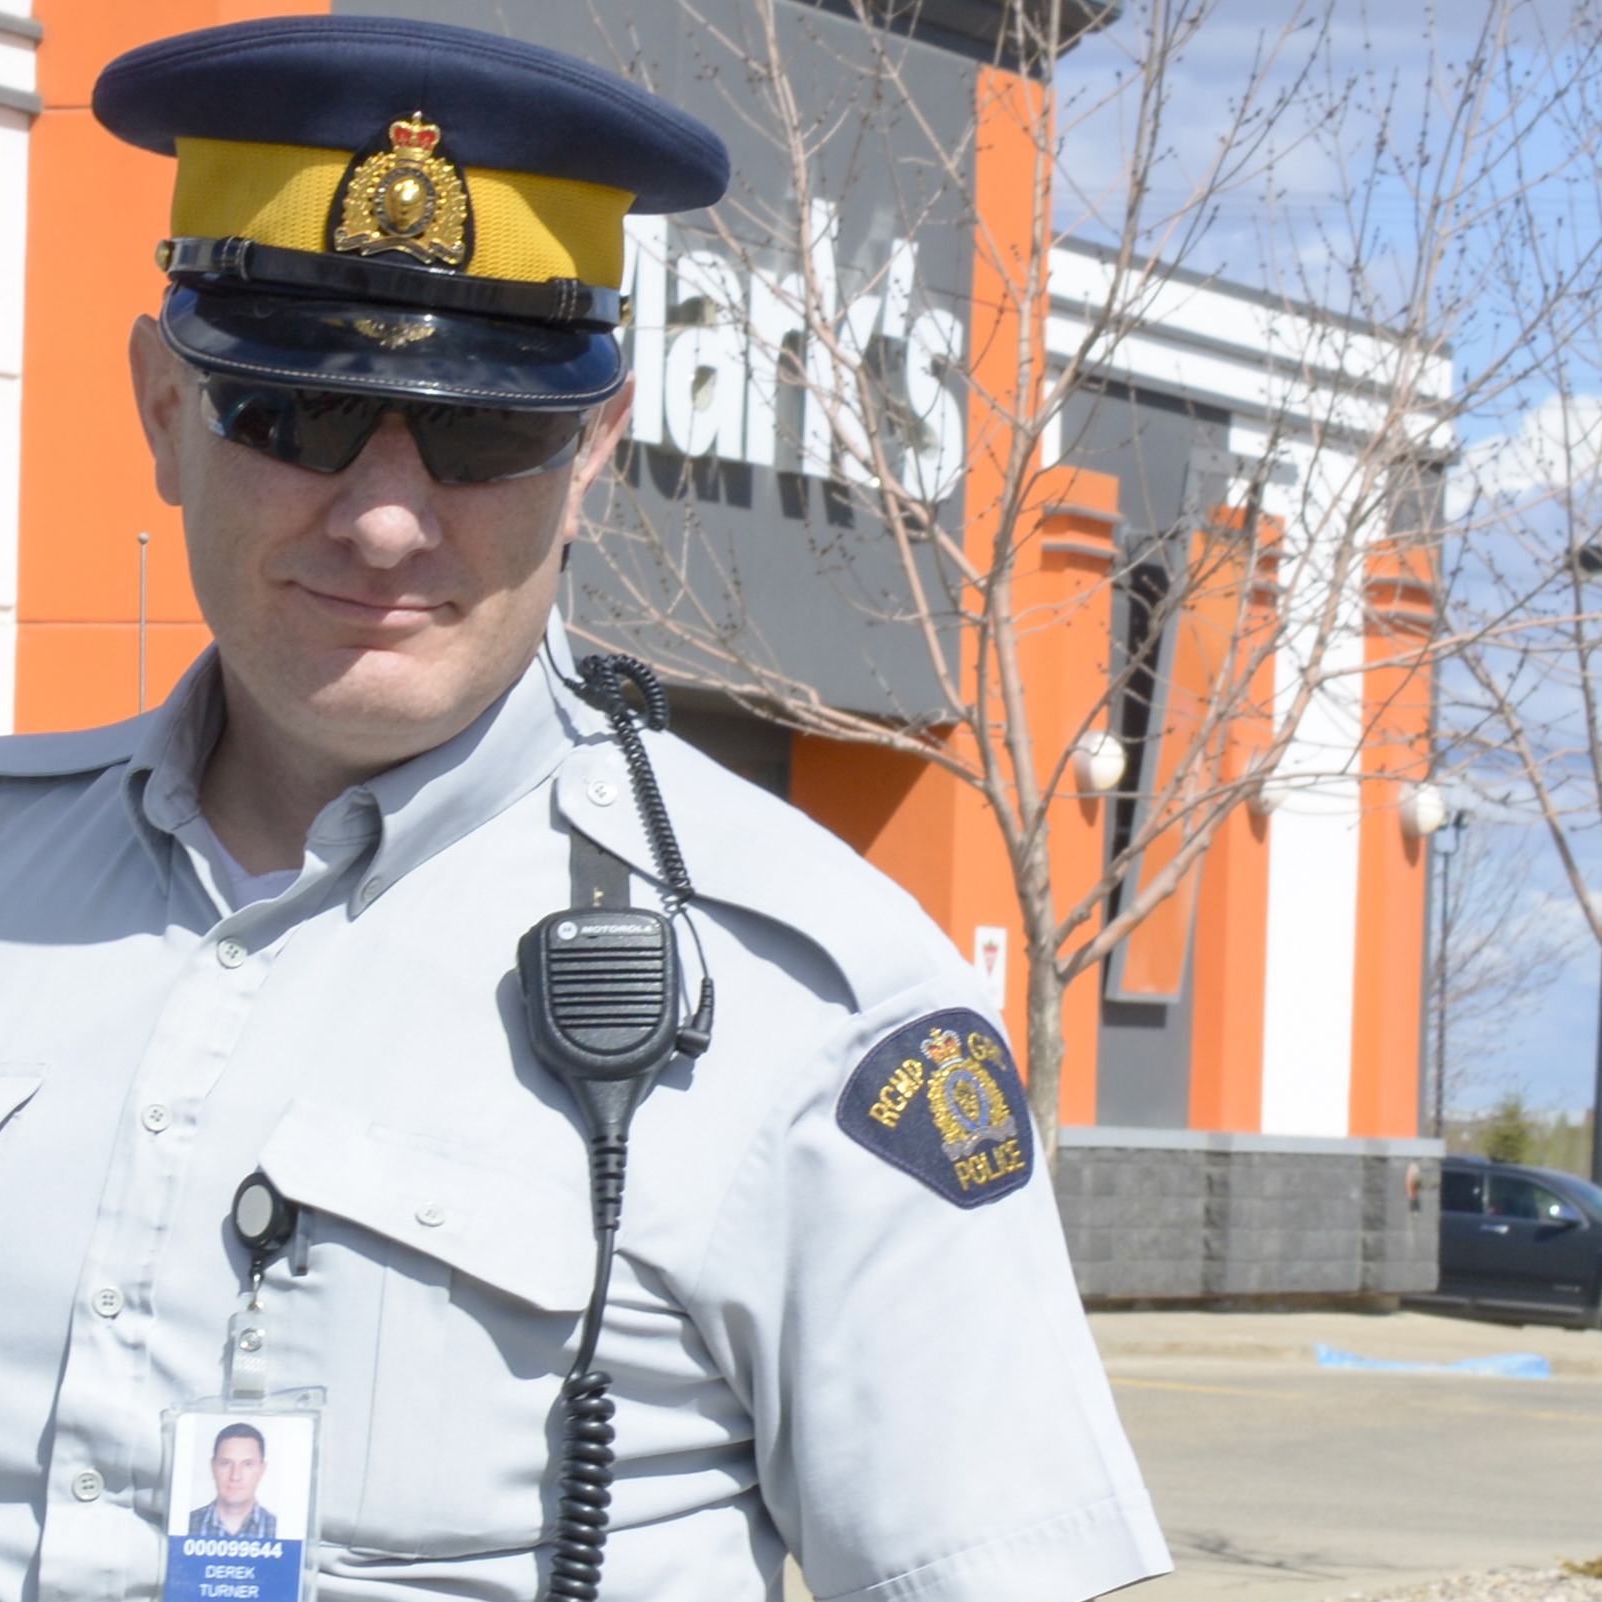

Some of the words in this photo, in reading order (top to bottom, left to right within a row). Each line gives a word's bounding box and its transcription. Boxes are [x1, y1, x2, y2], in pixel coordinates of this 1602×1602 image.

[868, 1058, 926, 1129] RCMP
[953, 1138, 1026, 1191] POLICE
[183, 1538, 283, 1559] 000099644
[204, 1564, 256, 1580] DEREK
[199, 1582, 260, 1599] TURNER
